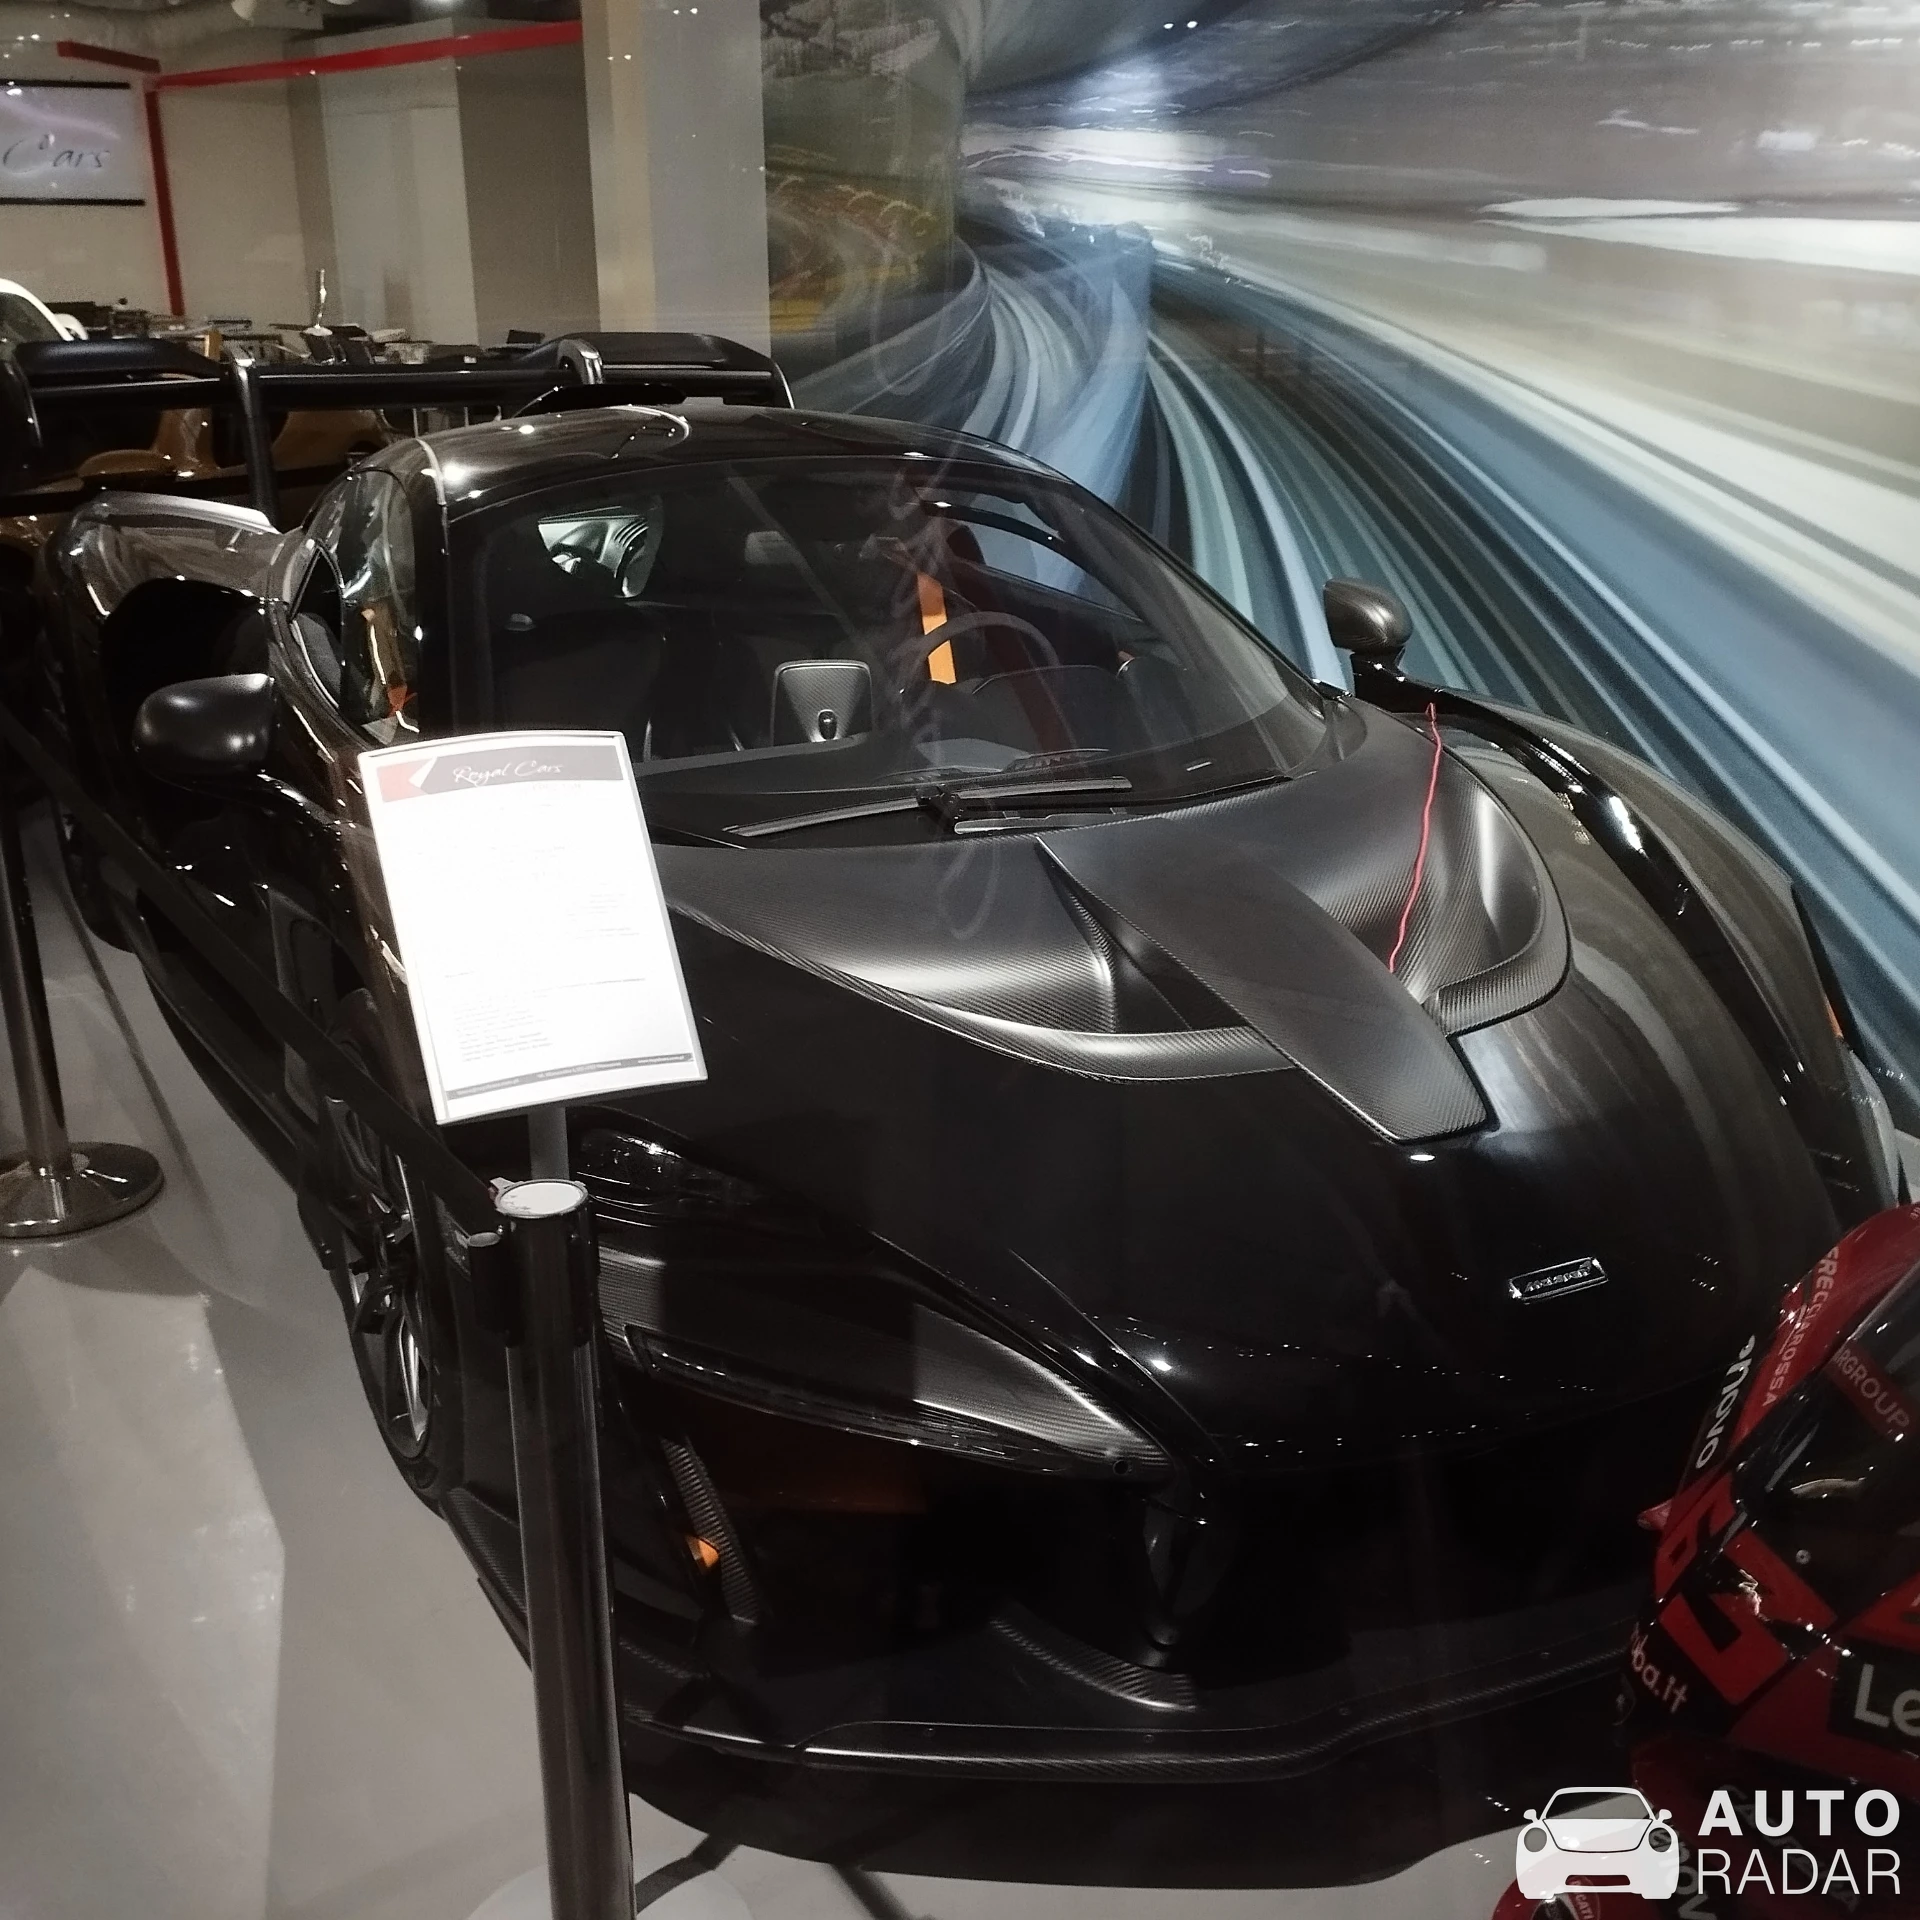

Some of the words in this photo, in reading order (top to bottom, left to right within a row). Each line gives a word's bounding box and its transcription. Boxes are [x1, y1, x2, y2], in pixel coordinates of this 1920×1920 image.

[2, 133, 111, 175] Cars
[452, 762, 512, 788] Royal
[514, 760, 564, 777] Cars
